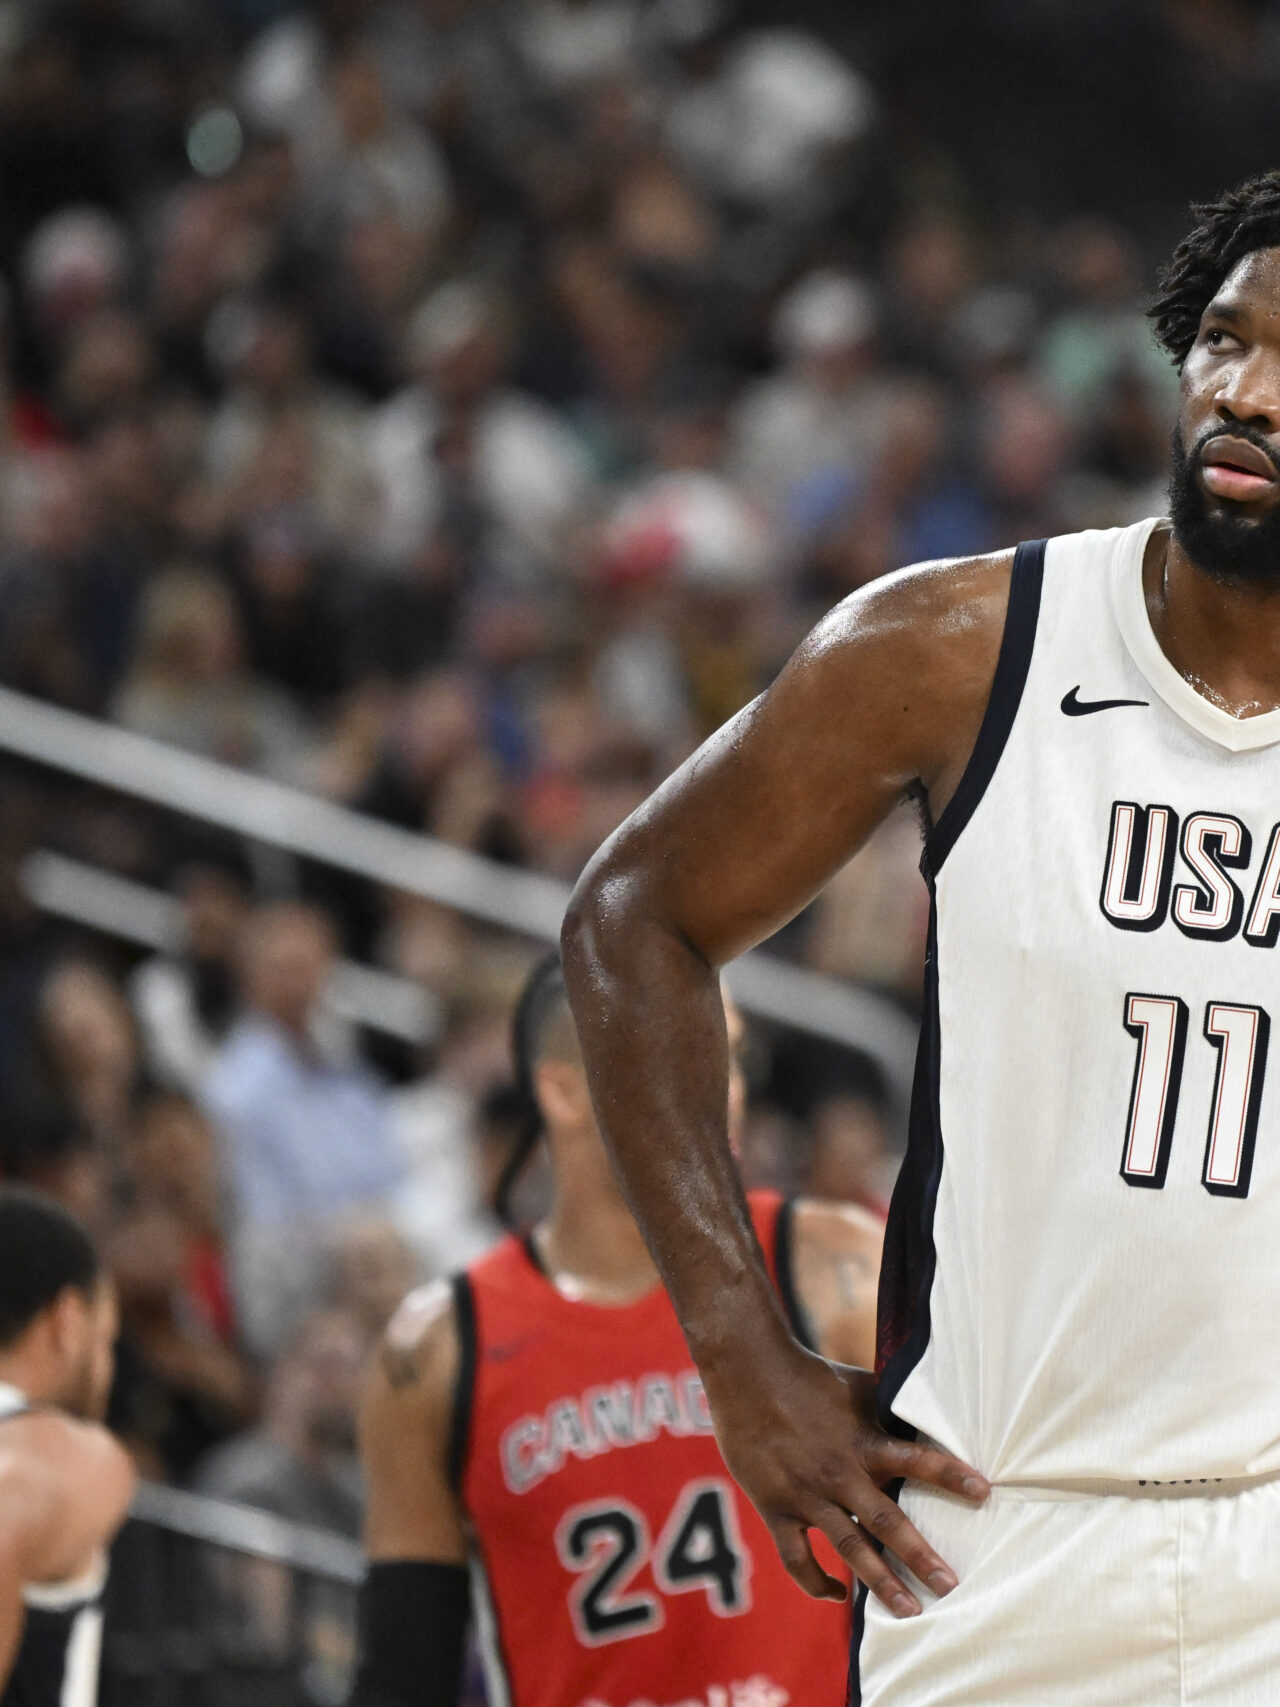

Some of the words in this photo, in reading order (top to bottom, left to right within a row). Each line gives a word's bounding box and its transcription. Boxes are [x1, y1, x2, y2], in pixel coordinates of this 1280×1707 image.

[1119, 992, 1271, 1199] 11
[500, 1368, 716, 1495] CANAD
[556, 1479, 751, 1646] 24
